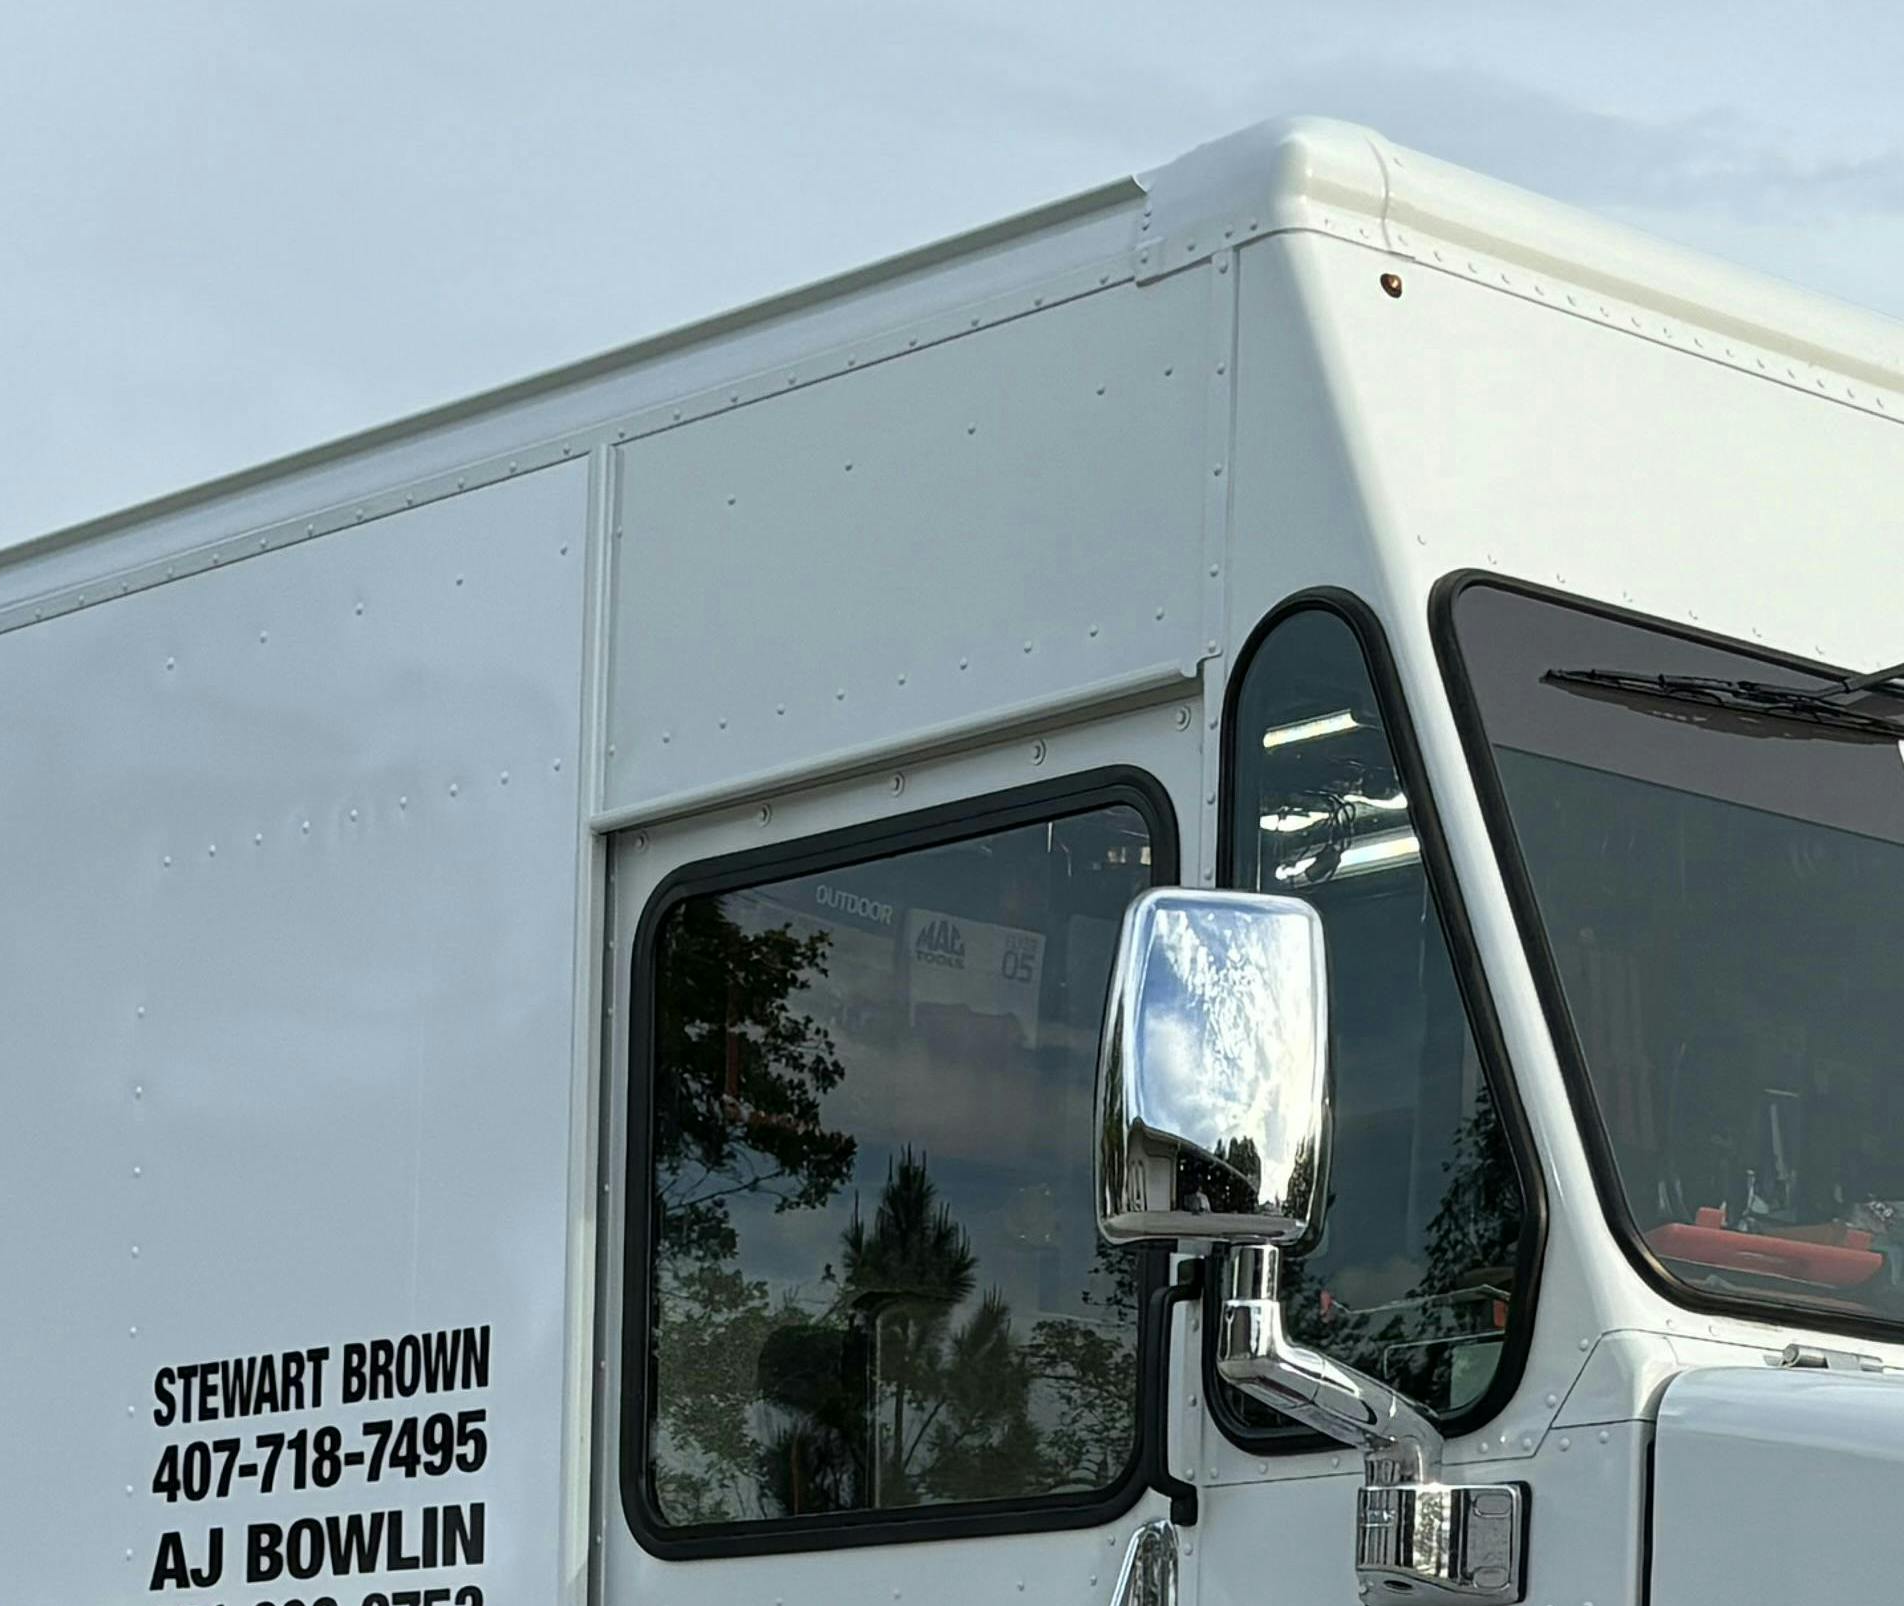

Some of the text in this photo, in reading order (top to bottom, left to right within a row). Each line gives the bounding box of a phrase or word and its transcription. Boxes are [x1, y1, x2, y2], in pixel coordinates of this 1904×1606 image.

[816, 885, 893, 926] OUTDOOR
[915, 920, 966, 957] MAC
[153, 1325, 491, 1428] STEWART BROWN
[151, 1408, 488, 1504] 407-718-7495
[149, 1502, 486, 1592] AJ BOWLIN
